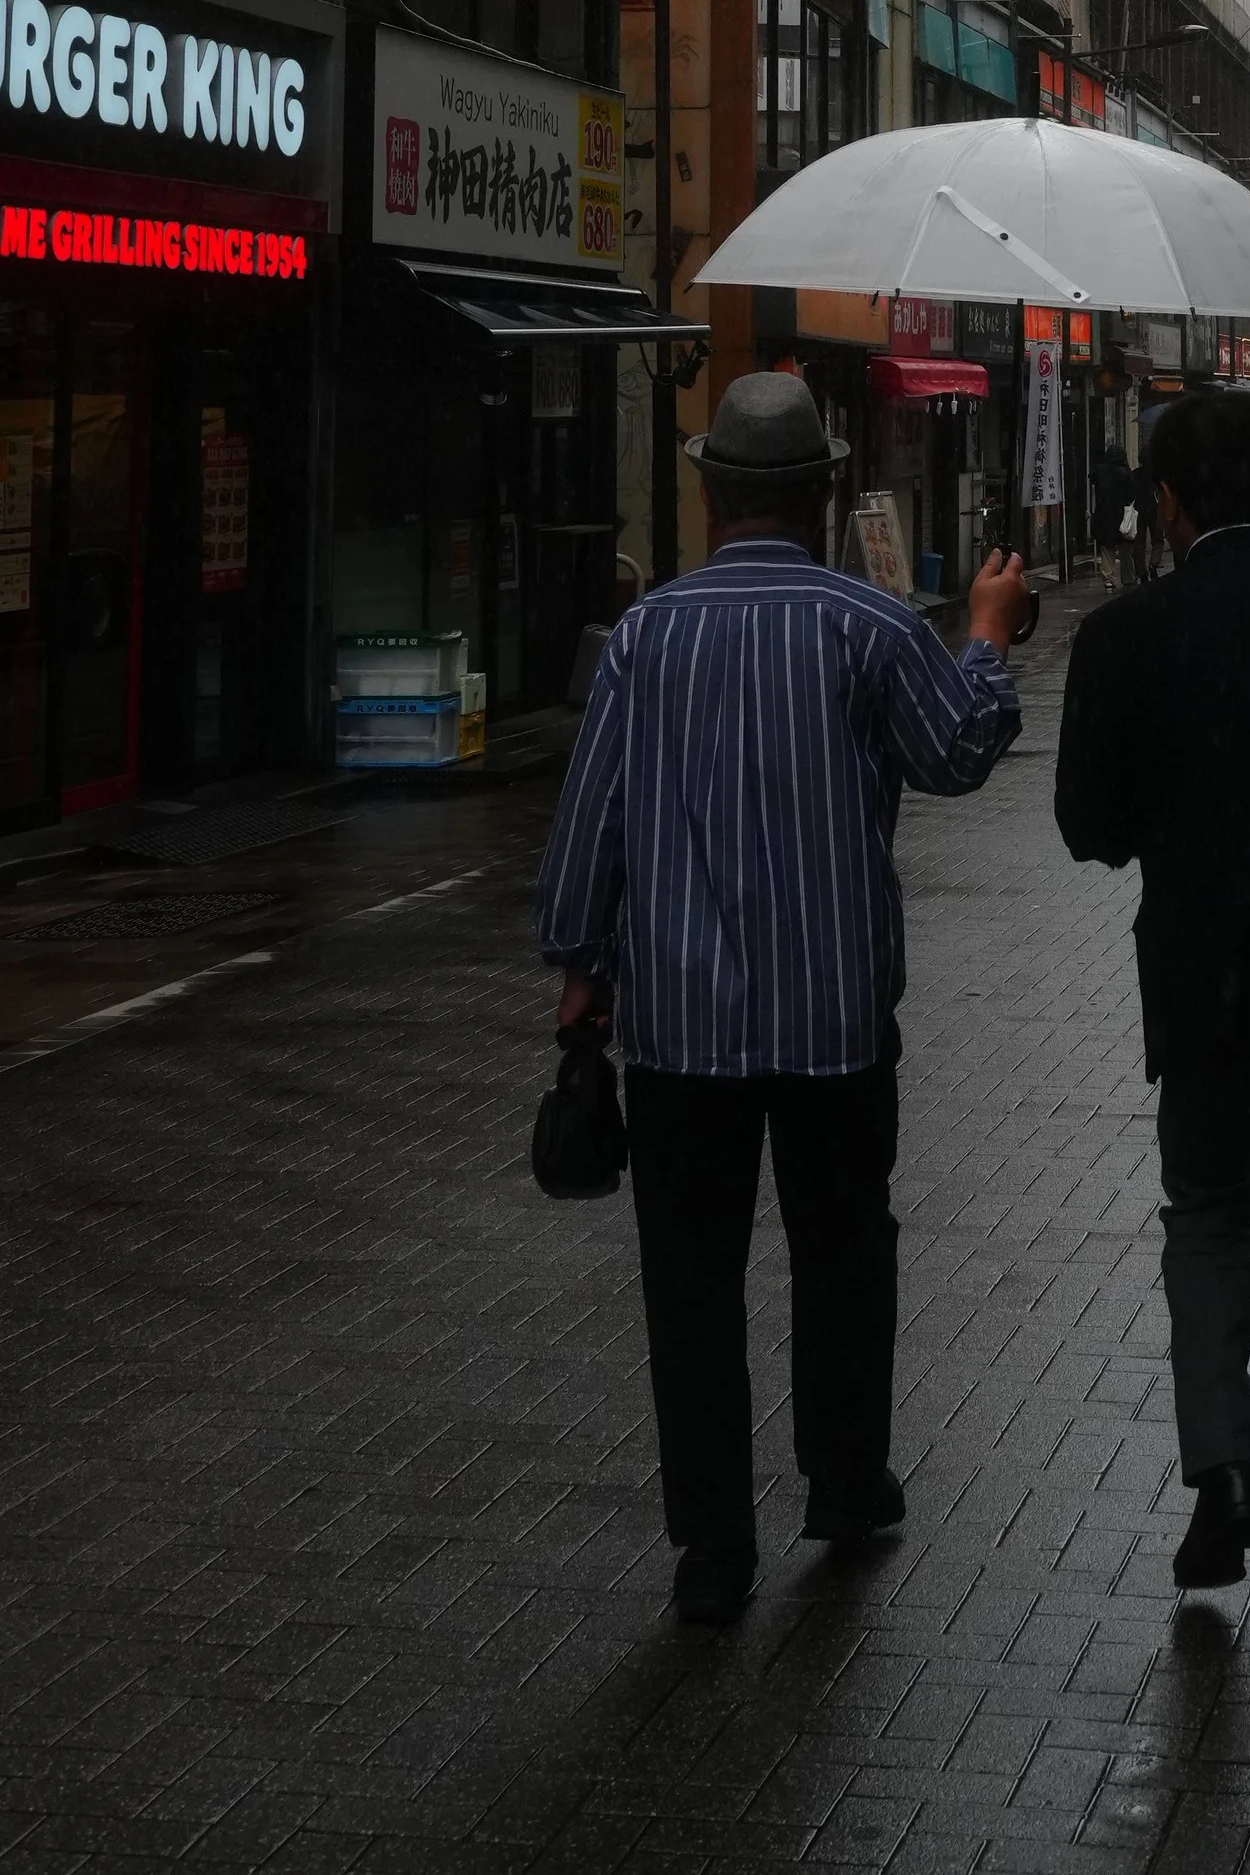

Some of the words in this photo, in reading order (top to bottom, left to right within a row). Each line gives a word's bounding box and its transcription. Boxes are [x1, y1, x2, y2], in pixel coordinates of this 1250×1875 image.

[183, 35, 304, 157] KING
[440, 75, 493, 122] Wagyu
[499, 91, 559, 138] Yakiniku
[389, 126, 417, 167] 和牛
[389, 170, 415, 208] 焼肉
[425, 124, 574, 239] 神田精肉店
[52, 210, 181, 270] GRILLING
[183, 222, 254, 276] SINCE
[254, 231, 308, 280] 1954
